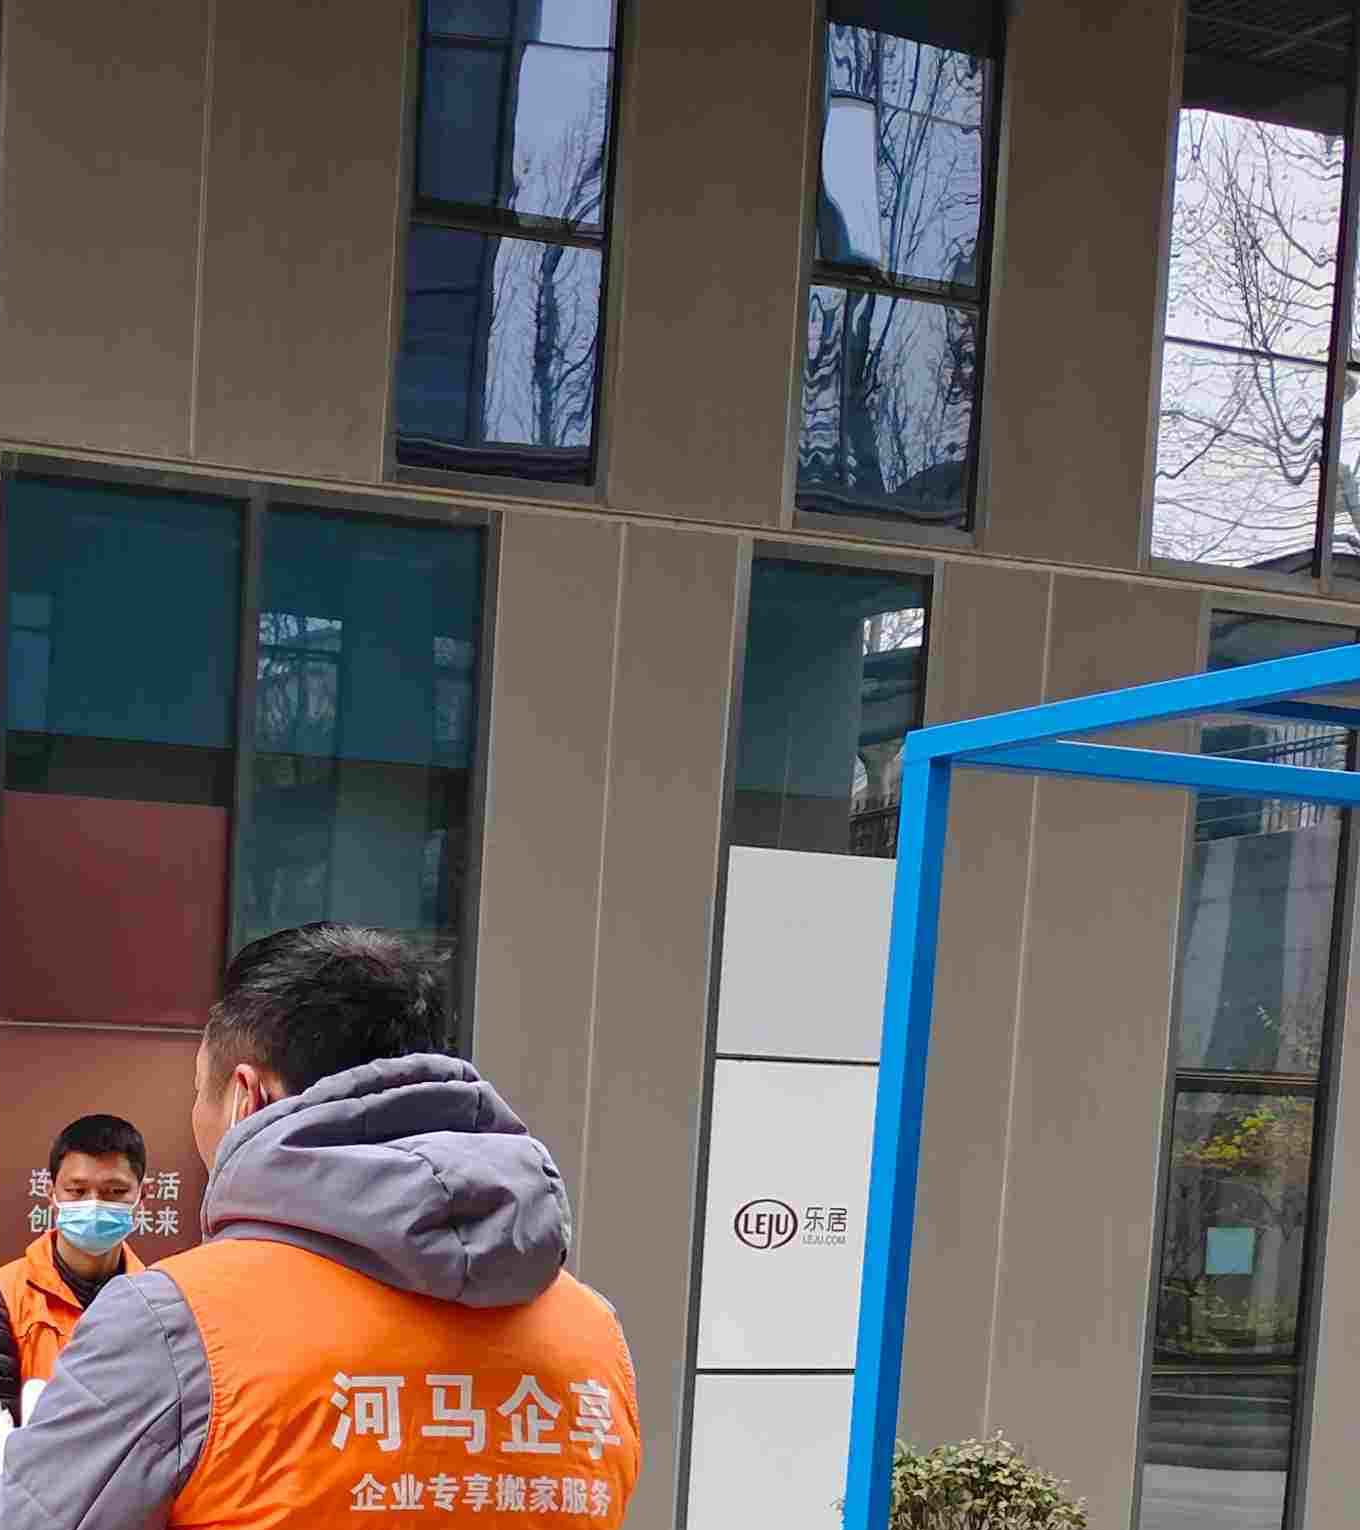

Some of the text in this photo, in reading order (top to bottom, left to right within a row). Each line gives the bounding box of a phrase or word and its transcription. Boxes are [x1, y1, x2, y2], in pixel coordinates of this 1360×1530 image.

[741, 1210, 791, 1248] LEJU
[802, 1206, 848, 1233] 乐居
[802, 1234, 846, 1246] LEJU.COM
[329, 1370, 623, 1461] 河马企享
[349, 1472, 612, 1518] 企业专享搬家服务
